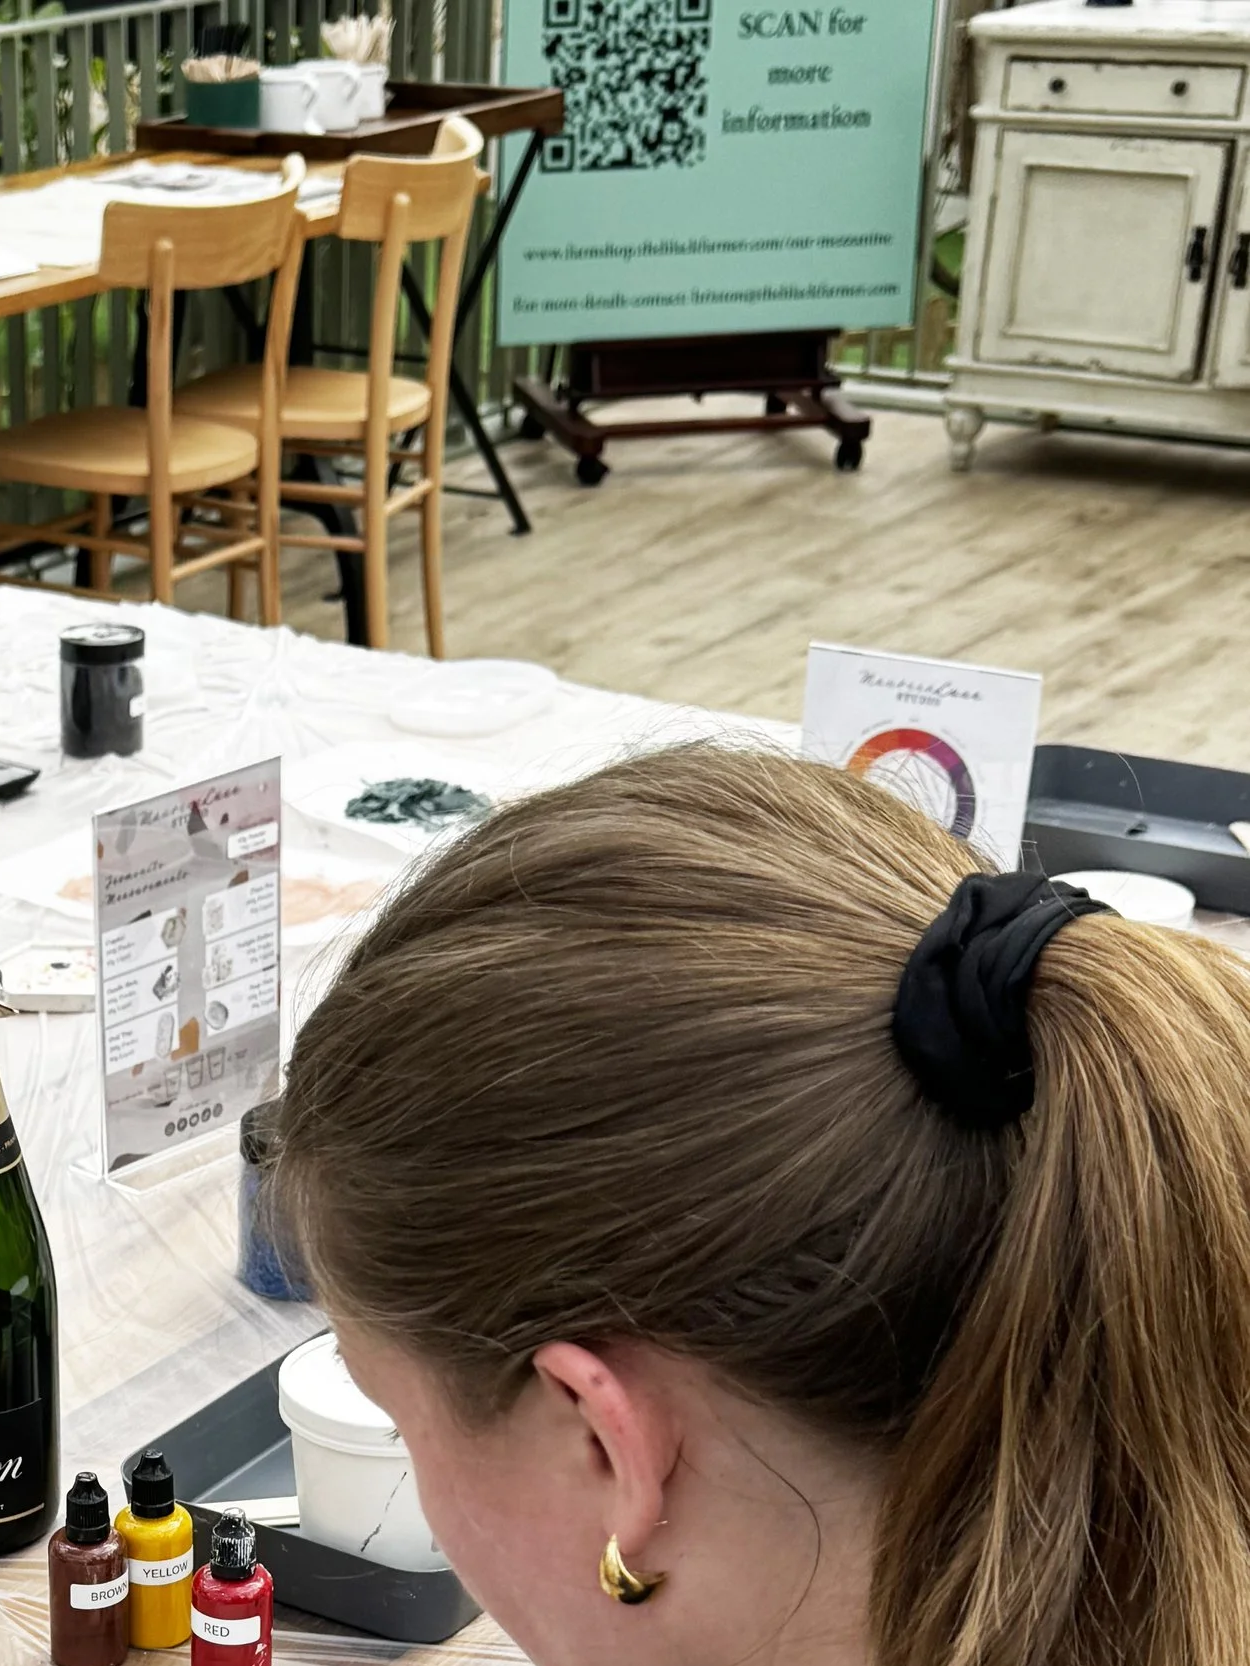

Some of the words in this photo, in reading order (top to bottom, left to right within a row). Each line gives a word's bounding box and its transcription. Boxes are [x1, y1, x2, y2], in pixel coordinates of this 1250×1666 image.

[737, 9, 823, 40] SCAN
[828, 6, 868, 36] for
[767, 64, 833, 85] more
[722, 103, 872, 135] information
[143, 1560, 189, 1579] YELLOW
[91, 1580, 128, 1602] BROWN
[204, 1622, 230, 1638] RED
